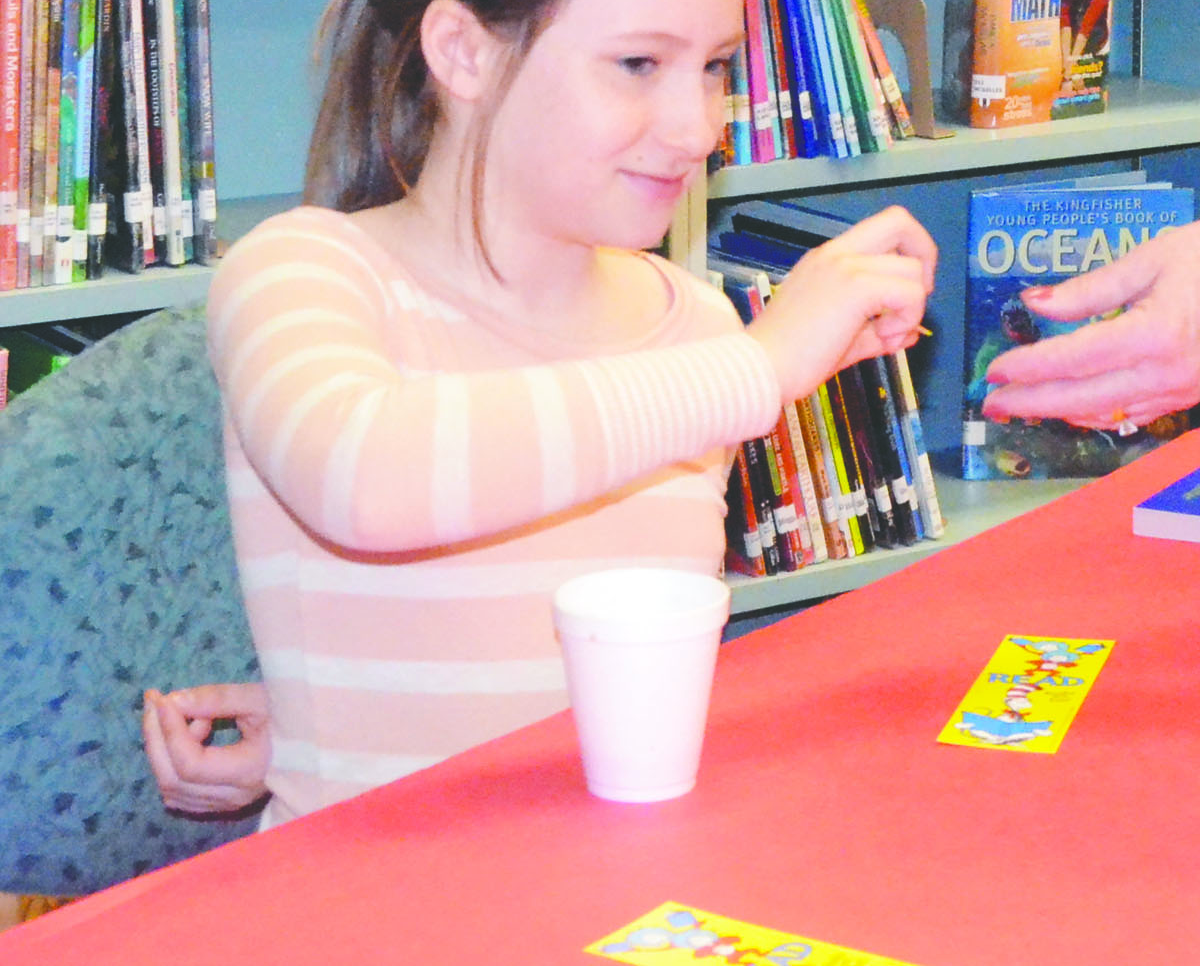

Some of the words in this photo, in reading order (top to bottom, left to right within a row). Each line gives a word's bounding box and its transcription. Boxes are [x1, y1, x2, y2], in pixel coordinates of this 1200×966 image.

[8, 22, 18, 52] and
[5, 55, 18, 131] Monsters
[1024, 200, 1051, 211] THE
[1056, 198, 1142, 211] KINGFISHER
[987, 214, 1036, 226] YOUNG
[1042, 213, 1109, 225] PEOPLE'S
[1115, 212, 1154, 224] BOOK
[1159, 211, 1178, 222] OF
[977, 226, 1180, 275] OCEAN
[988, 672, 1086, 687] READ
